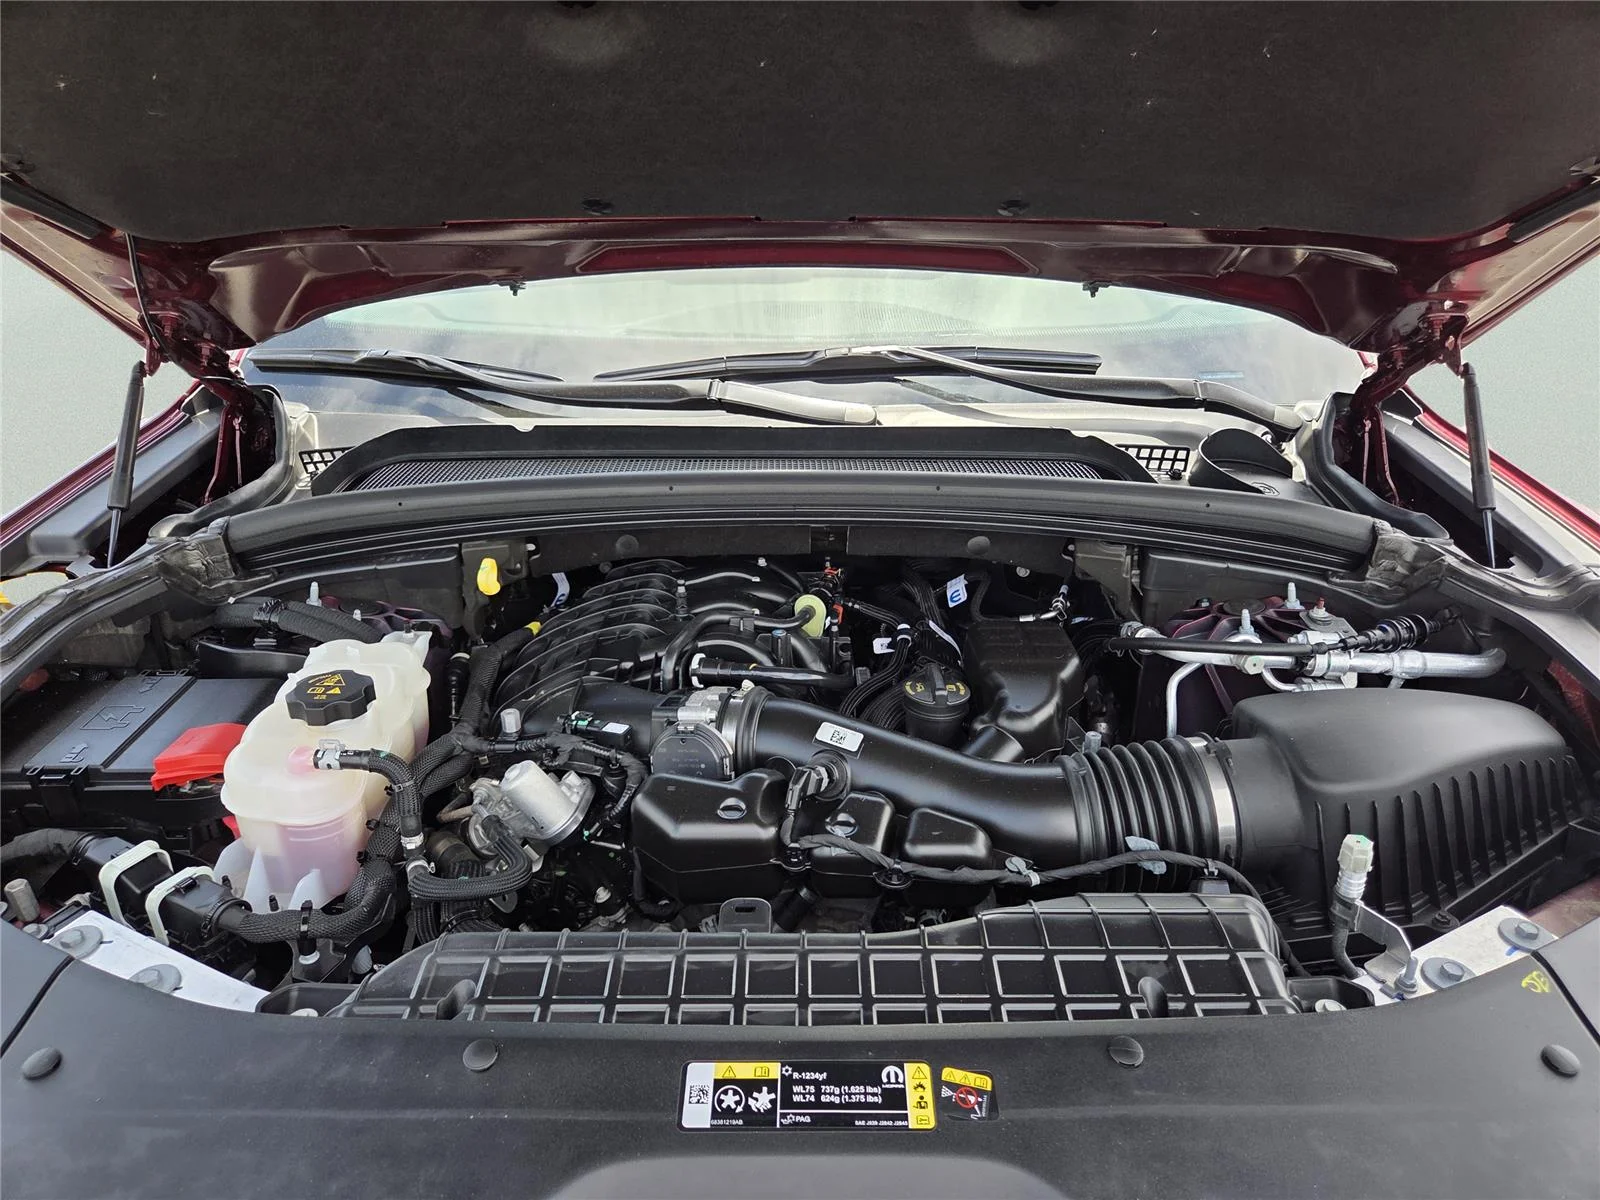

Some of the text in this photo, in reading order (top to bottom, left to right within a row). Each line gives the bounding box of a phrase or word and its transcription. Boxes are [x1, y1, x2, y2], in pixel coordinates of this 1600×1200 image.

[792, 1072, 827, 1081] R-1234yf
[792, 1085, 882, 1094] WL75 737g (1.625 lbs)
[792, 1094, 882, 1104] WL74 624g (1.375 lbs)
[795, 1115, 811, 1123] PAG
